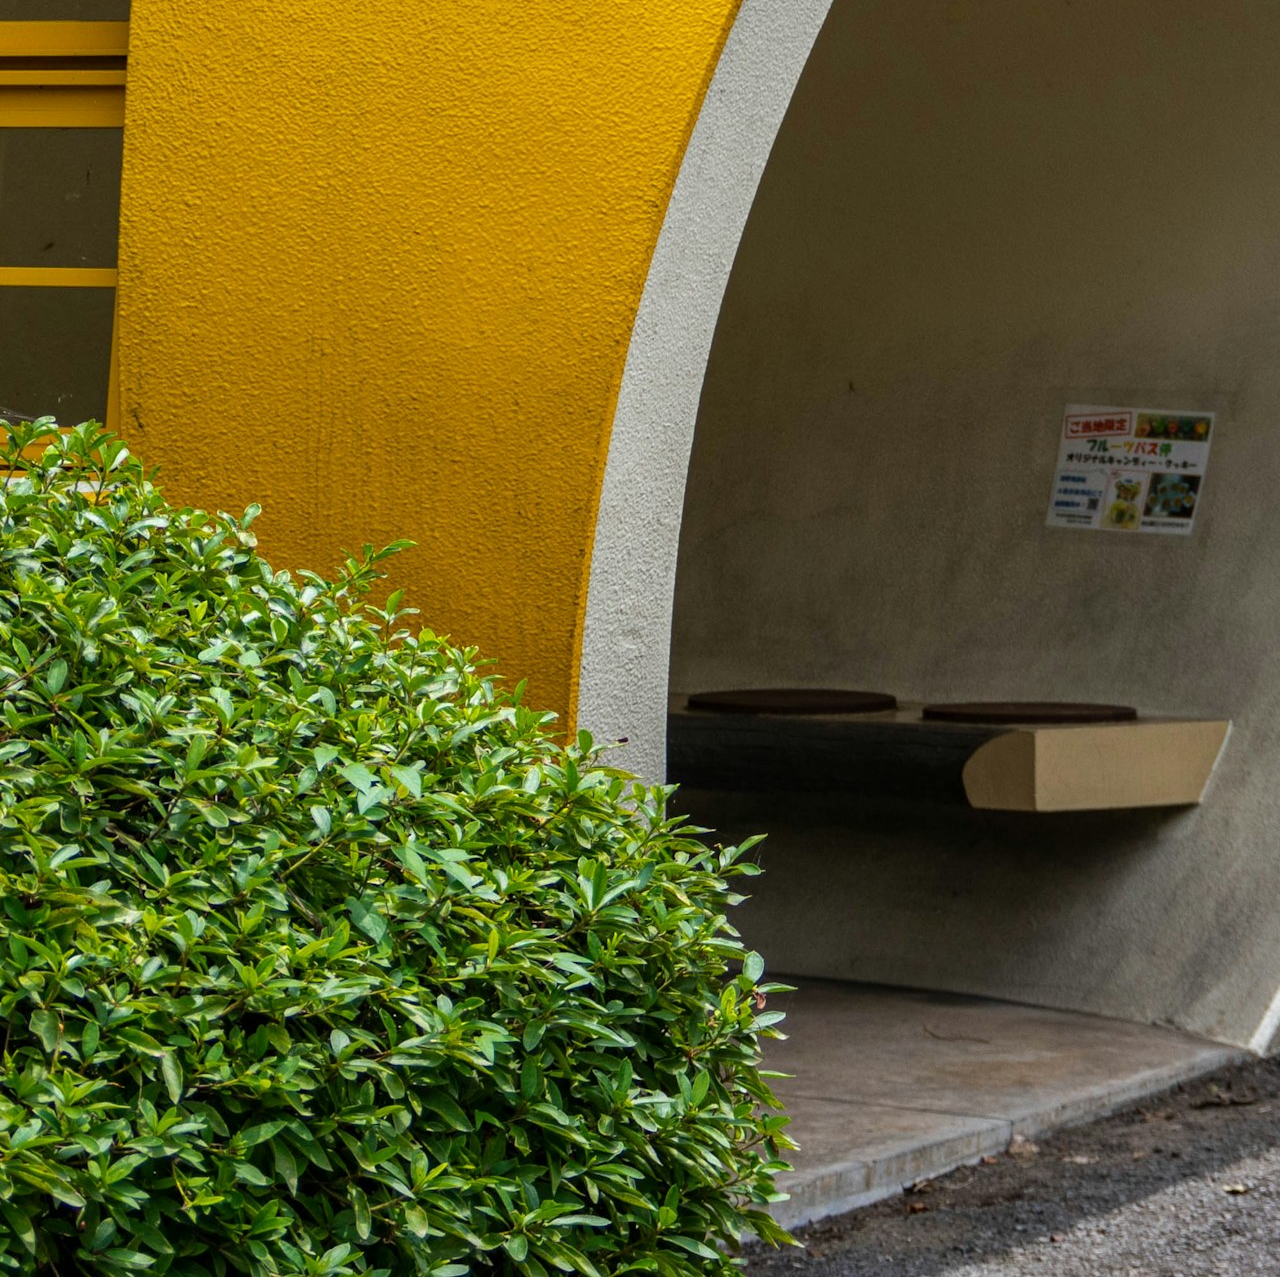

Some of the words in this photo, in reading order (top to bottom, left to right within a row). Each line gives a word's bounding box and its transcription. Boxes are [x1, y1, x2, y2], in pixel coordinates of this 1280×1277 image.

[1070, 418, 1128, 434] ご当地限定
[1086, 439, 1173, 457] フルーツバス停
